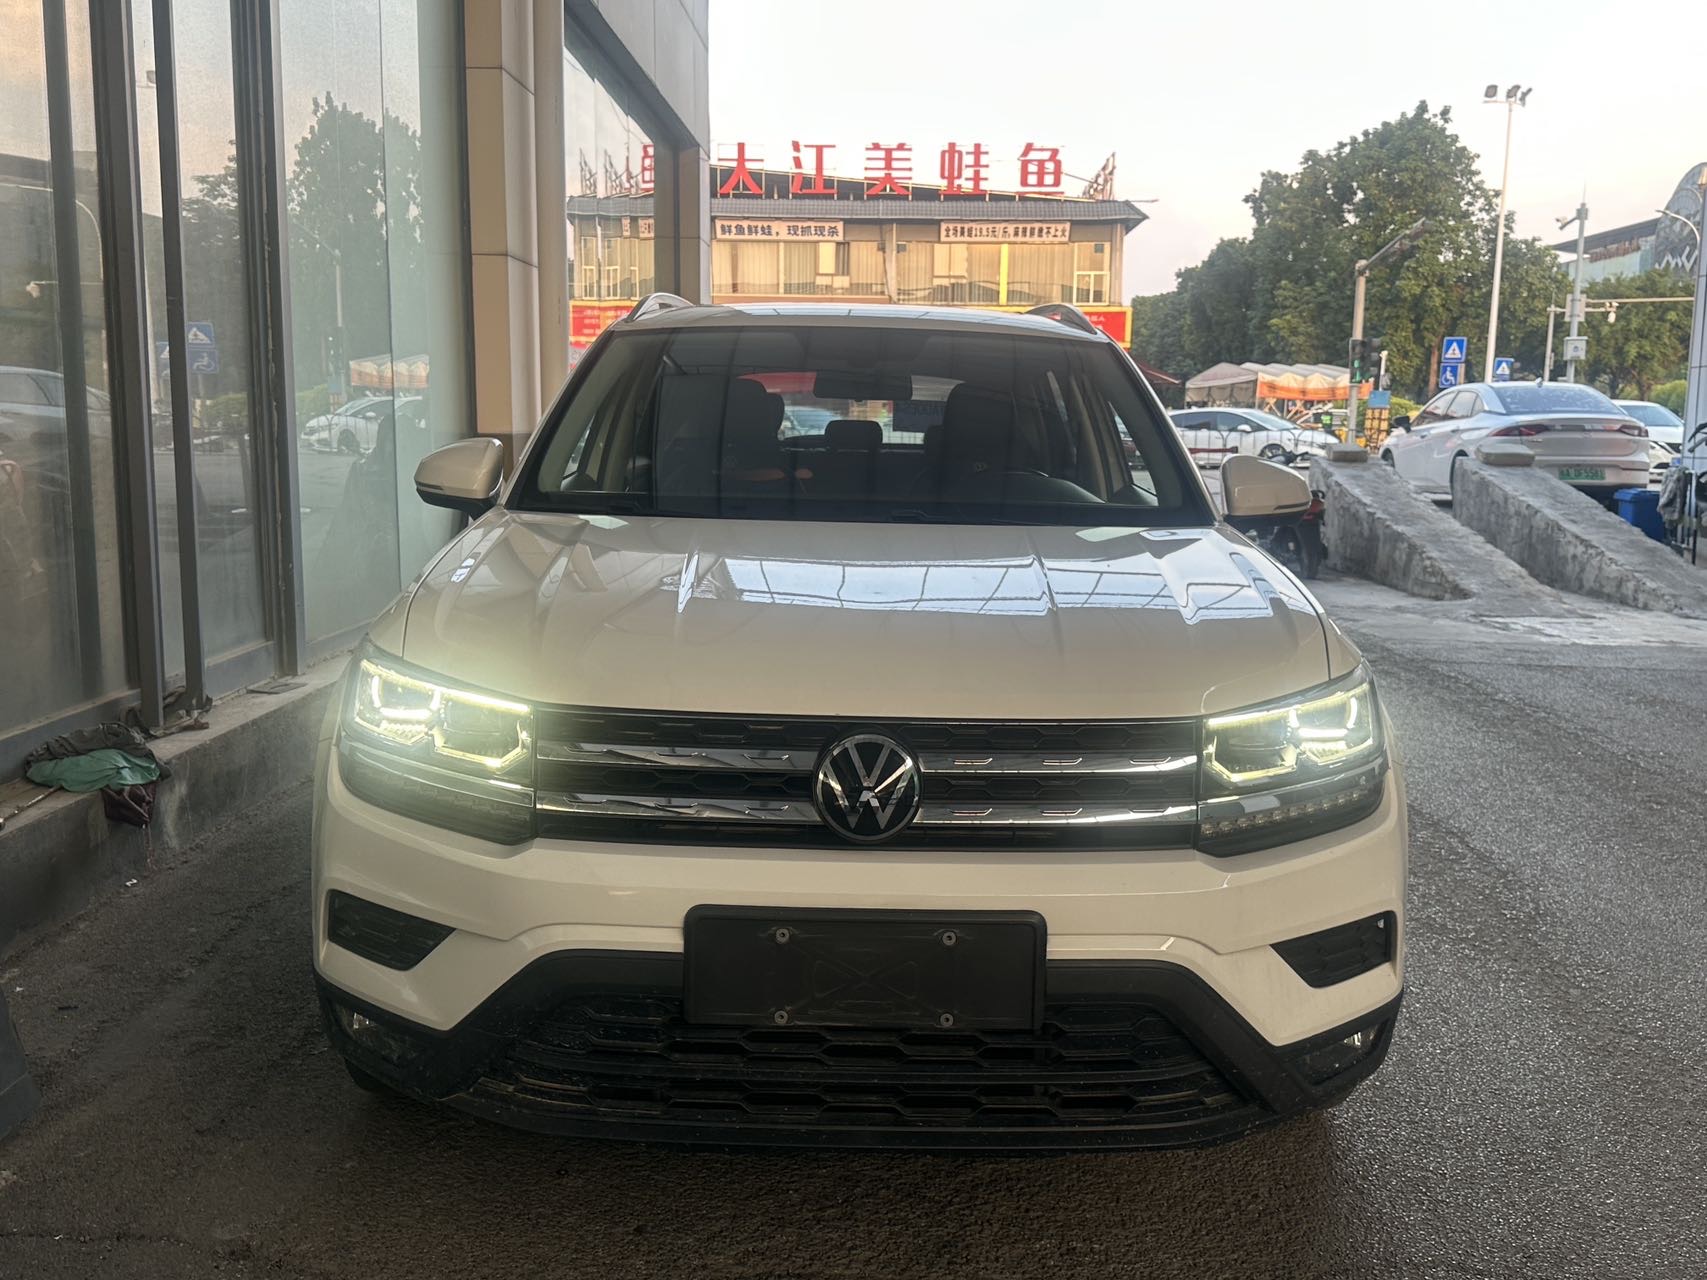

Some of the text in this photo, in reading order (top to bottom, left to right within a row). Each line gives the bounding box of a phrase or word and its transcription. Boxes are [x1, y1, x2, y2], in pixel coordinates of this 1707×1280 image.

[717, 140, 1065, 195] 大江美蛙鱼
[817, 734, 920, 840] VW
